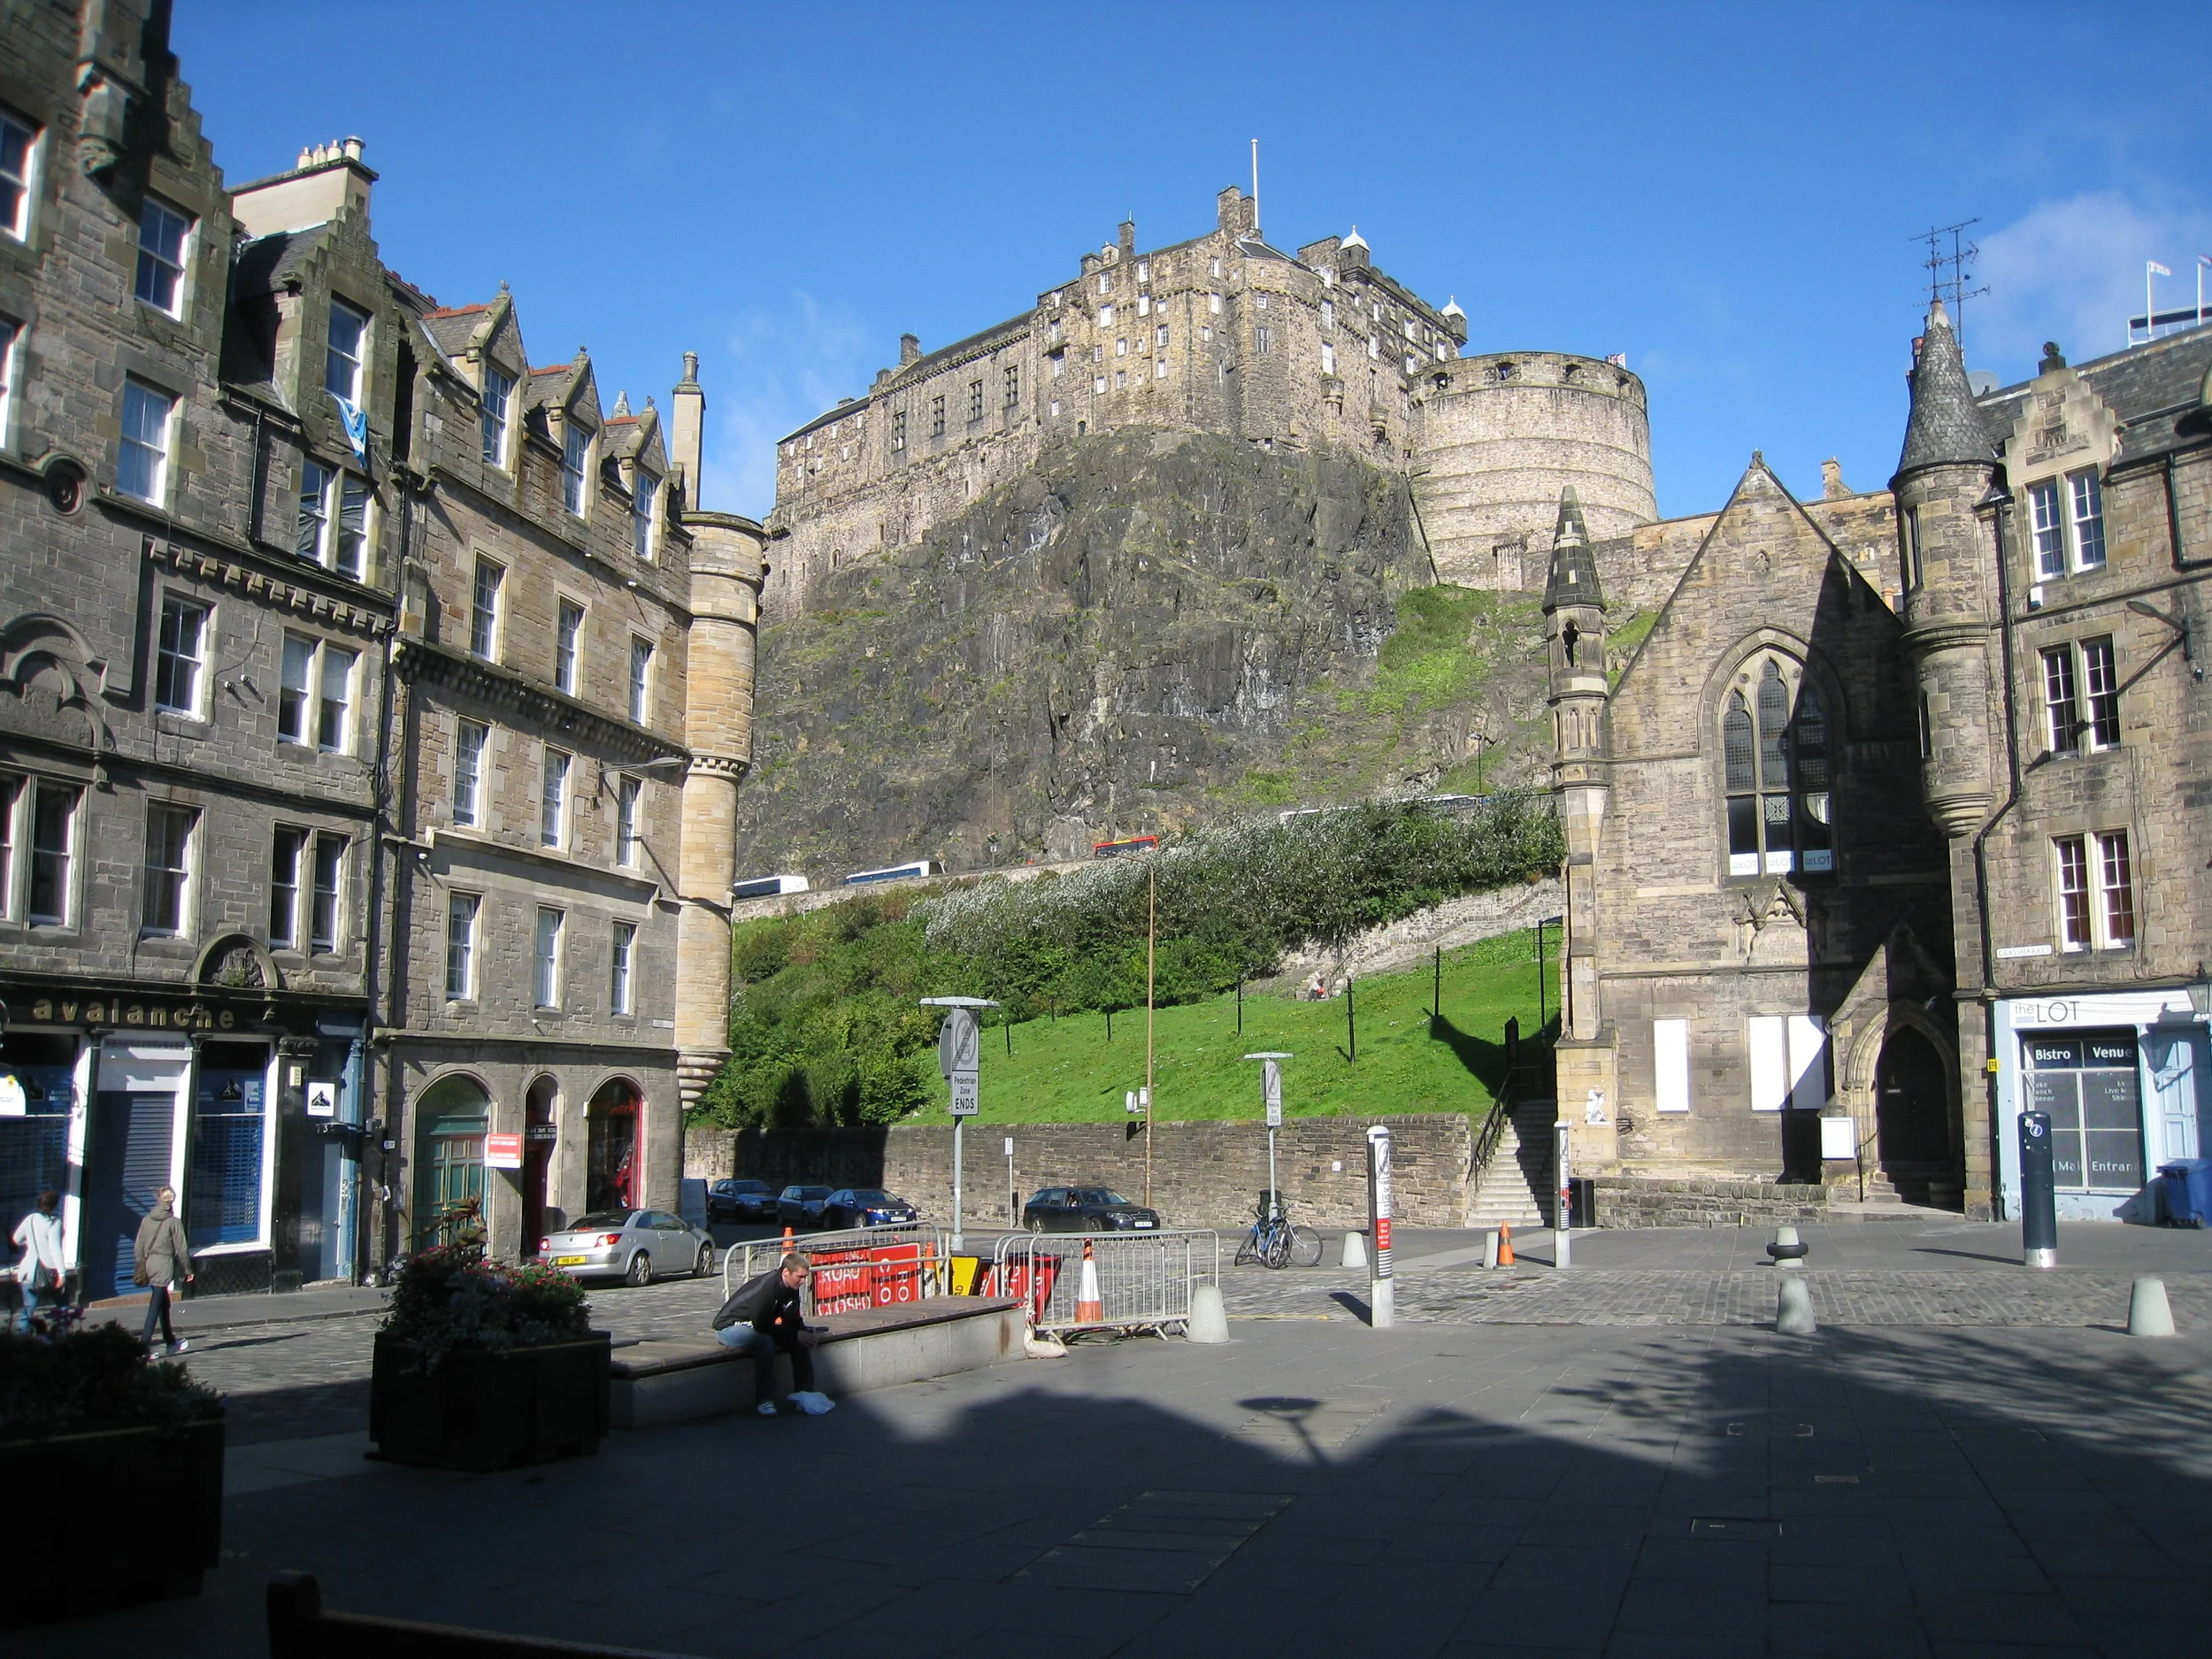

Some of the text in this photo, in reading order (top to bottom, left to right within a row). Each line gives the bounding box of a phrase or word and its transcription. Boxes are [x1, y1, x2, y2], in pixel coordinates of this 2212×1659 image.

[1813, 856, 1831, 865] LOT
[1998, 946, 2051, 956] GRASSMARKET
[33, 998, 234, 1029] avalanche
[2015, 1001, 2079, 1022] the LOT
[2035, 1048, 2071, 1061] Bistro
[2093, 1046, 2132, 1058] Venue
[956, 1098, 975, 1110] ENDS
[818, 1263, 860, 1283] ROAD
